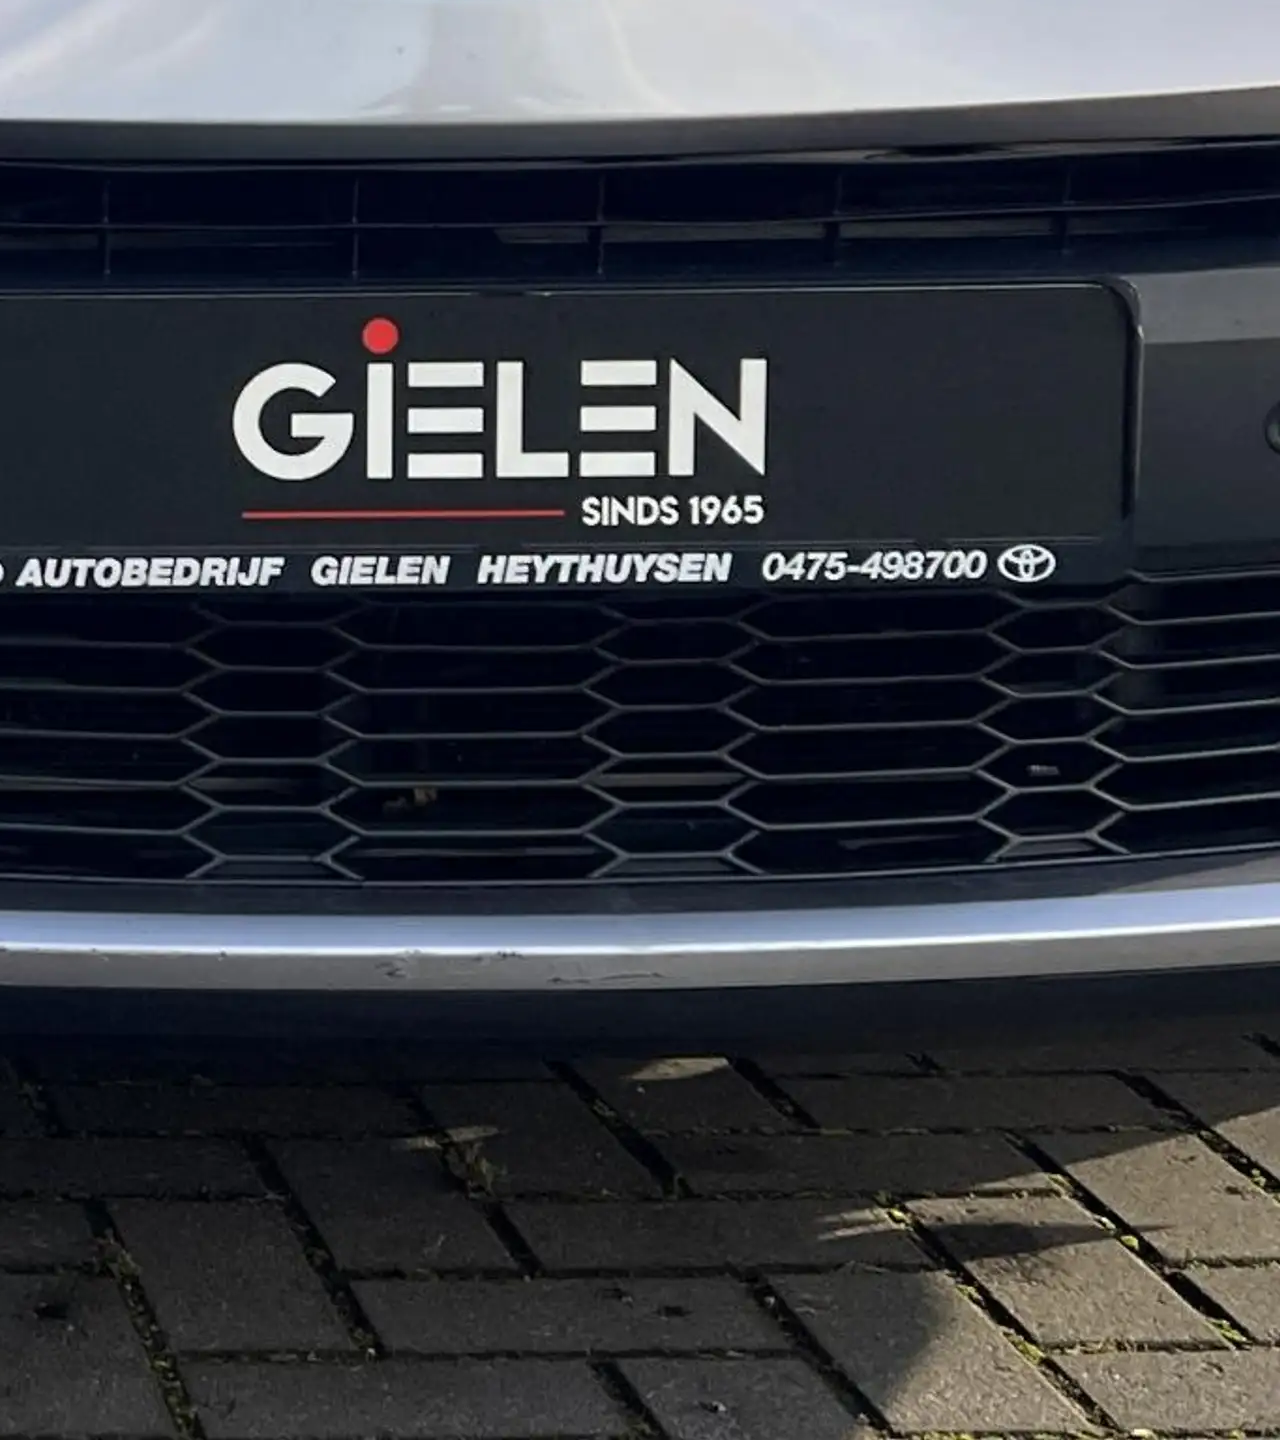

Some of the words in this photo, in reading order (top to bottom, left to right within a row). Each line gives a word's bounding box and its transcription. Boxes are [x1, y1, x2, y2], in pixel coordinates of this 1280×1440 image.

[232, 317, 768, 481] GIELEN
[581, 496, 680, 527] SINDS
[688, 495, 765, 525] 1965
[15, 556, 285, 589] AUTOBEDRIJF
[310, 555, 451, 586] GIELEN
[476, 552, 733, 584] HEYTHUYSEN
[760, 549, 988, 582] 0475-498700
